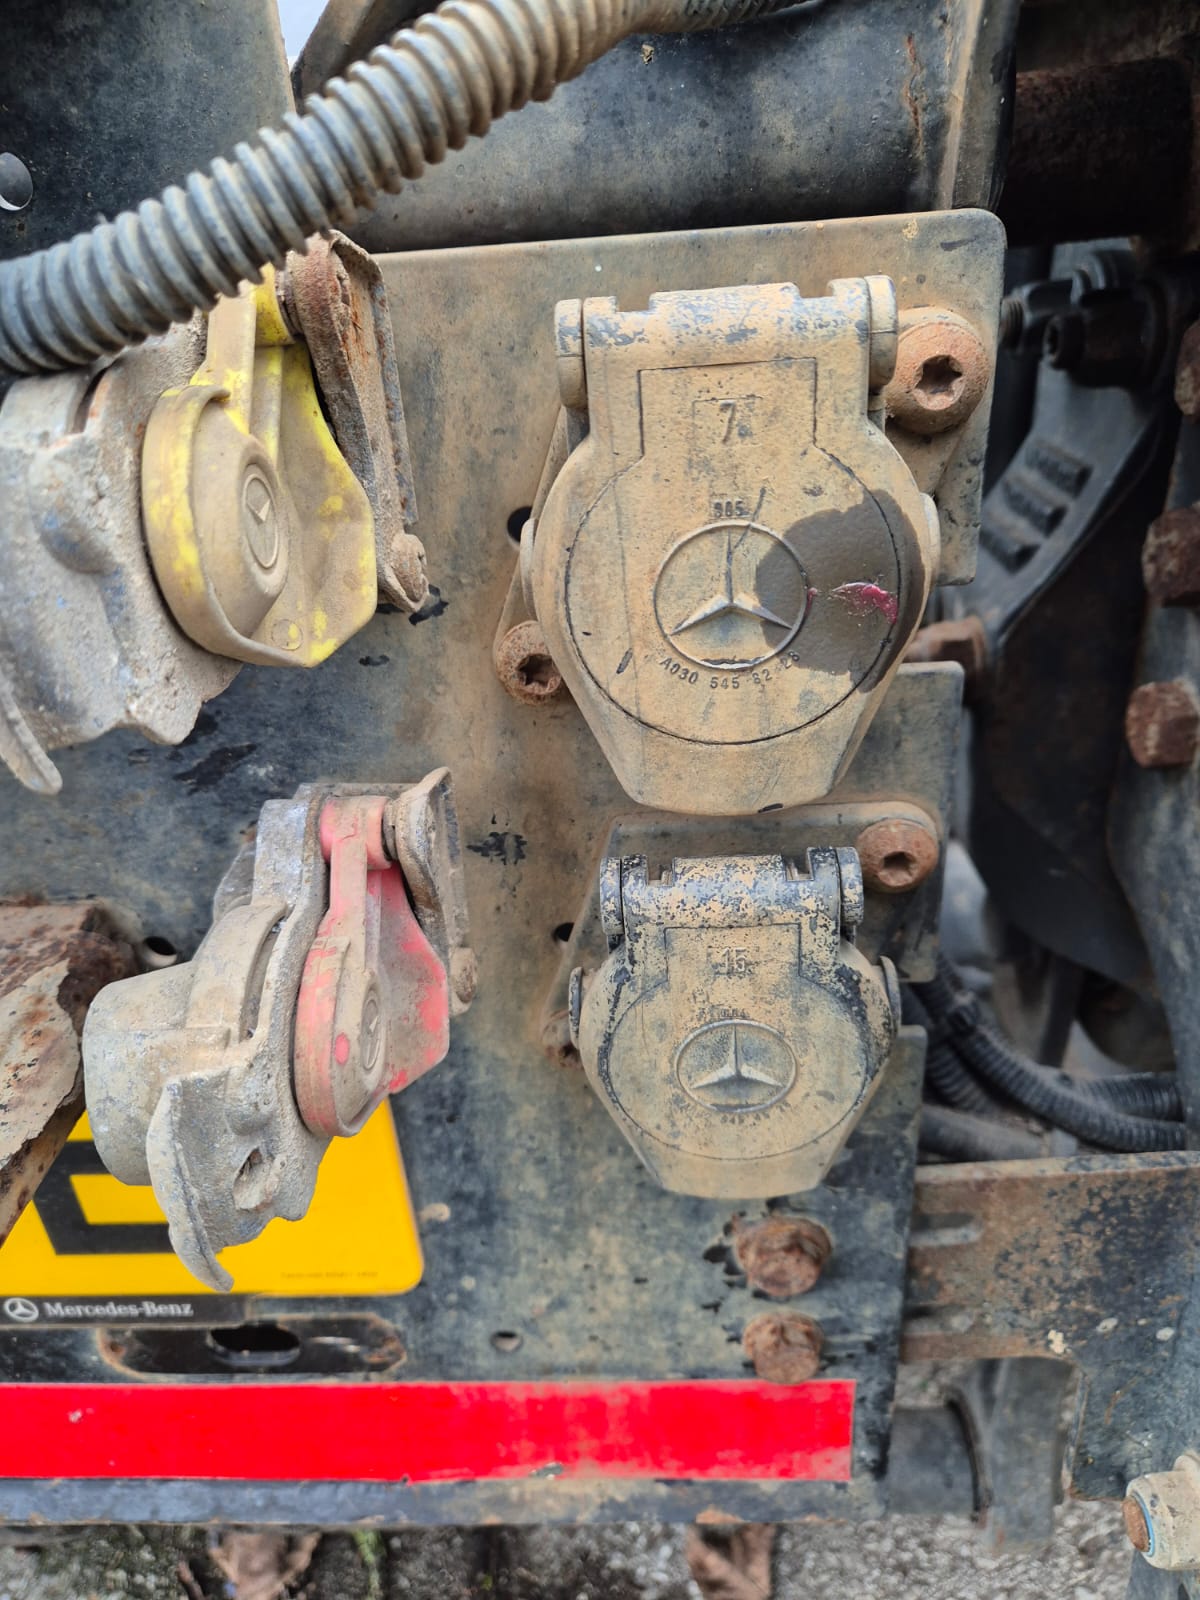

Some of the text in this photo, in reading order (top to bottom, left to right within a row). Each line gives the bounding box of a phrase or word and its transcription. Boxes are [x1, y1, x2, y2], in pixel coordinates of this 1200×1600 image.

[719, 400, 737, 444] 7
[660, 656, 699, 685] A030
[709, 675, 740, 690] 545
[780, 650, 801, 670] 28
[721, 947, 748, 974] 15
[43, 1301, 194, 1318] Mercedes-Benz
